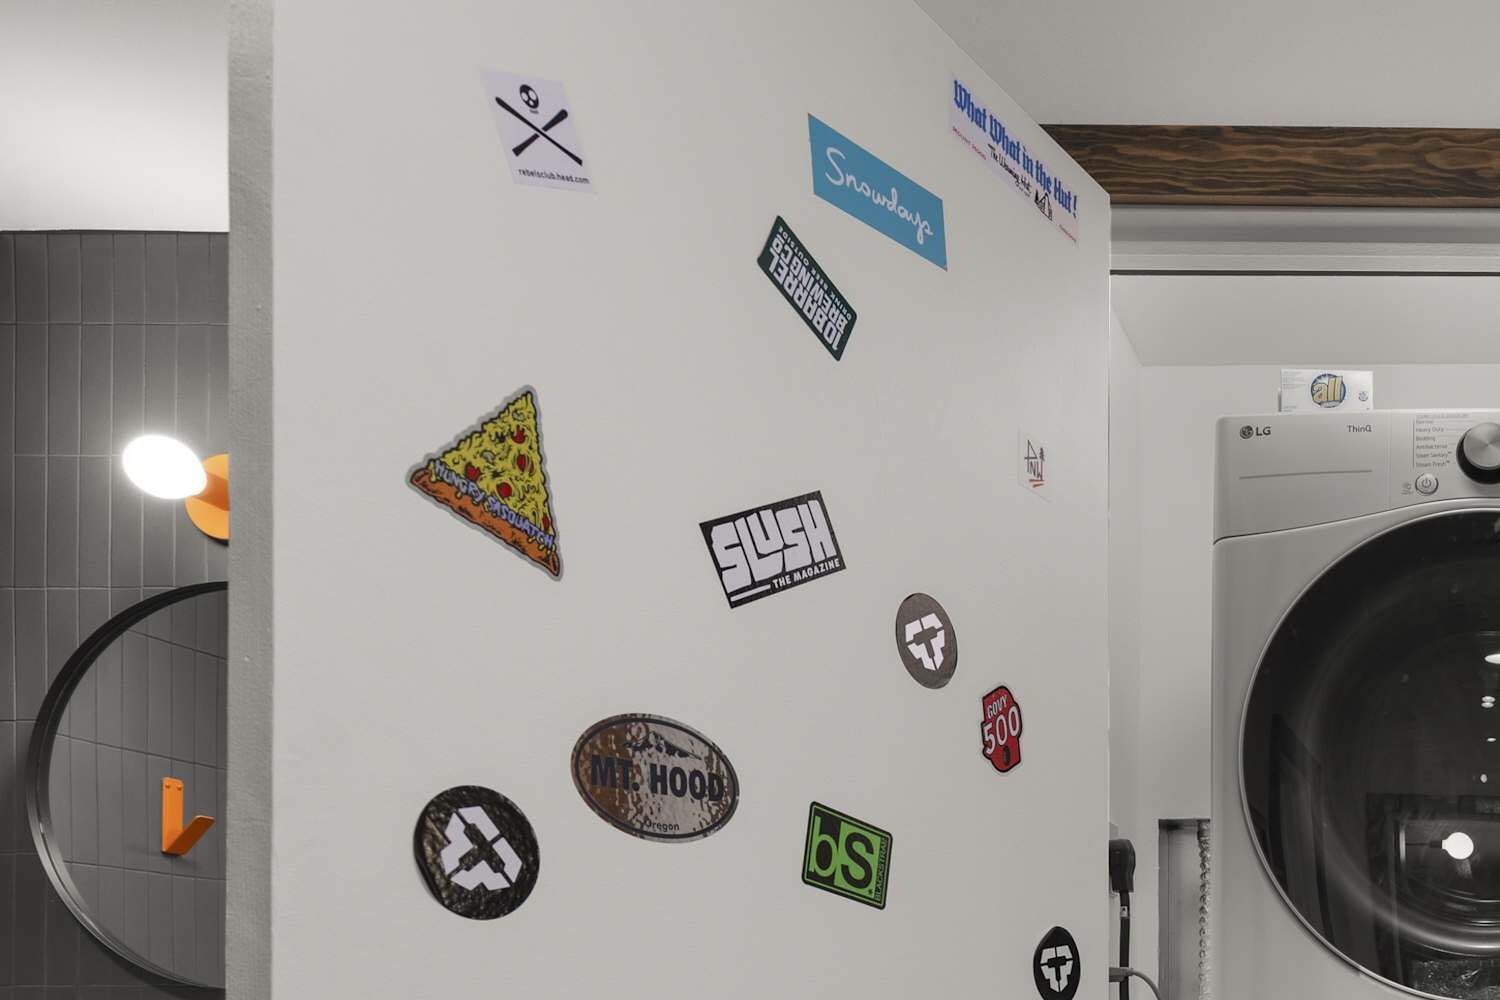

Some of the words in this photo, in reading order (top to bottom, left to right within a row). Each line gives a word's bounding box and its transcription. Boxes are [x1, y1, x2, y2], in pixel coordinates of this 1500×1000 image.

[953, 79, 987, 132] What
[989, 114, 1021, 165] What
[1022, 145, 1034, 178] in
[1035, 159, 1052, 193] the
[824, 146, 934, 245] Snowdays
[1312, 376, 1343, 404] all
[1255, 426, 1272, 437] LG
[1347, 424, 1373, 433] ThinQ
[435, 459, 485, 502] HUNGRY
[487, 497, 556, 548] SASQUATCH
[710, 499, 838, 594] SLUSH
[772, 574, 792, 589] THE
[793, 558, 841, 583] MAGAZINE
[986, 694, 1008, 719] GOVY
[983, 705, 1020, 755] 500
[591, 754, 641, 792] MT.
[649, 763, 725, 801] HOOD
[646, 817, 680, 832] Oregon
